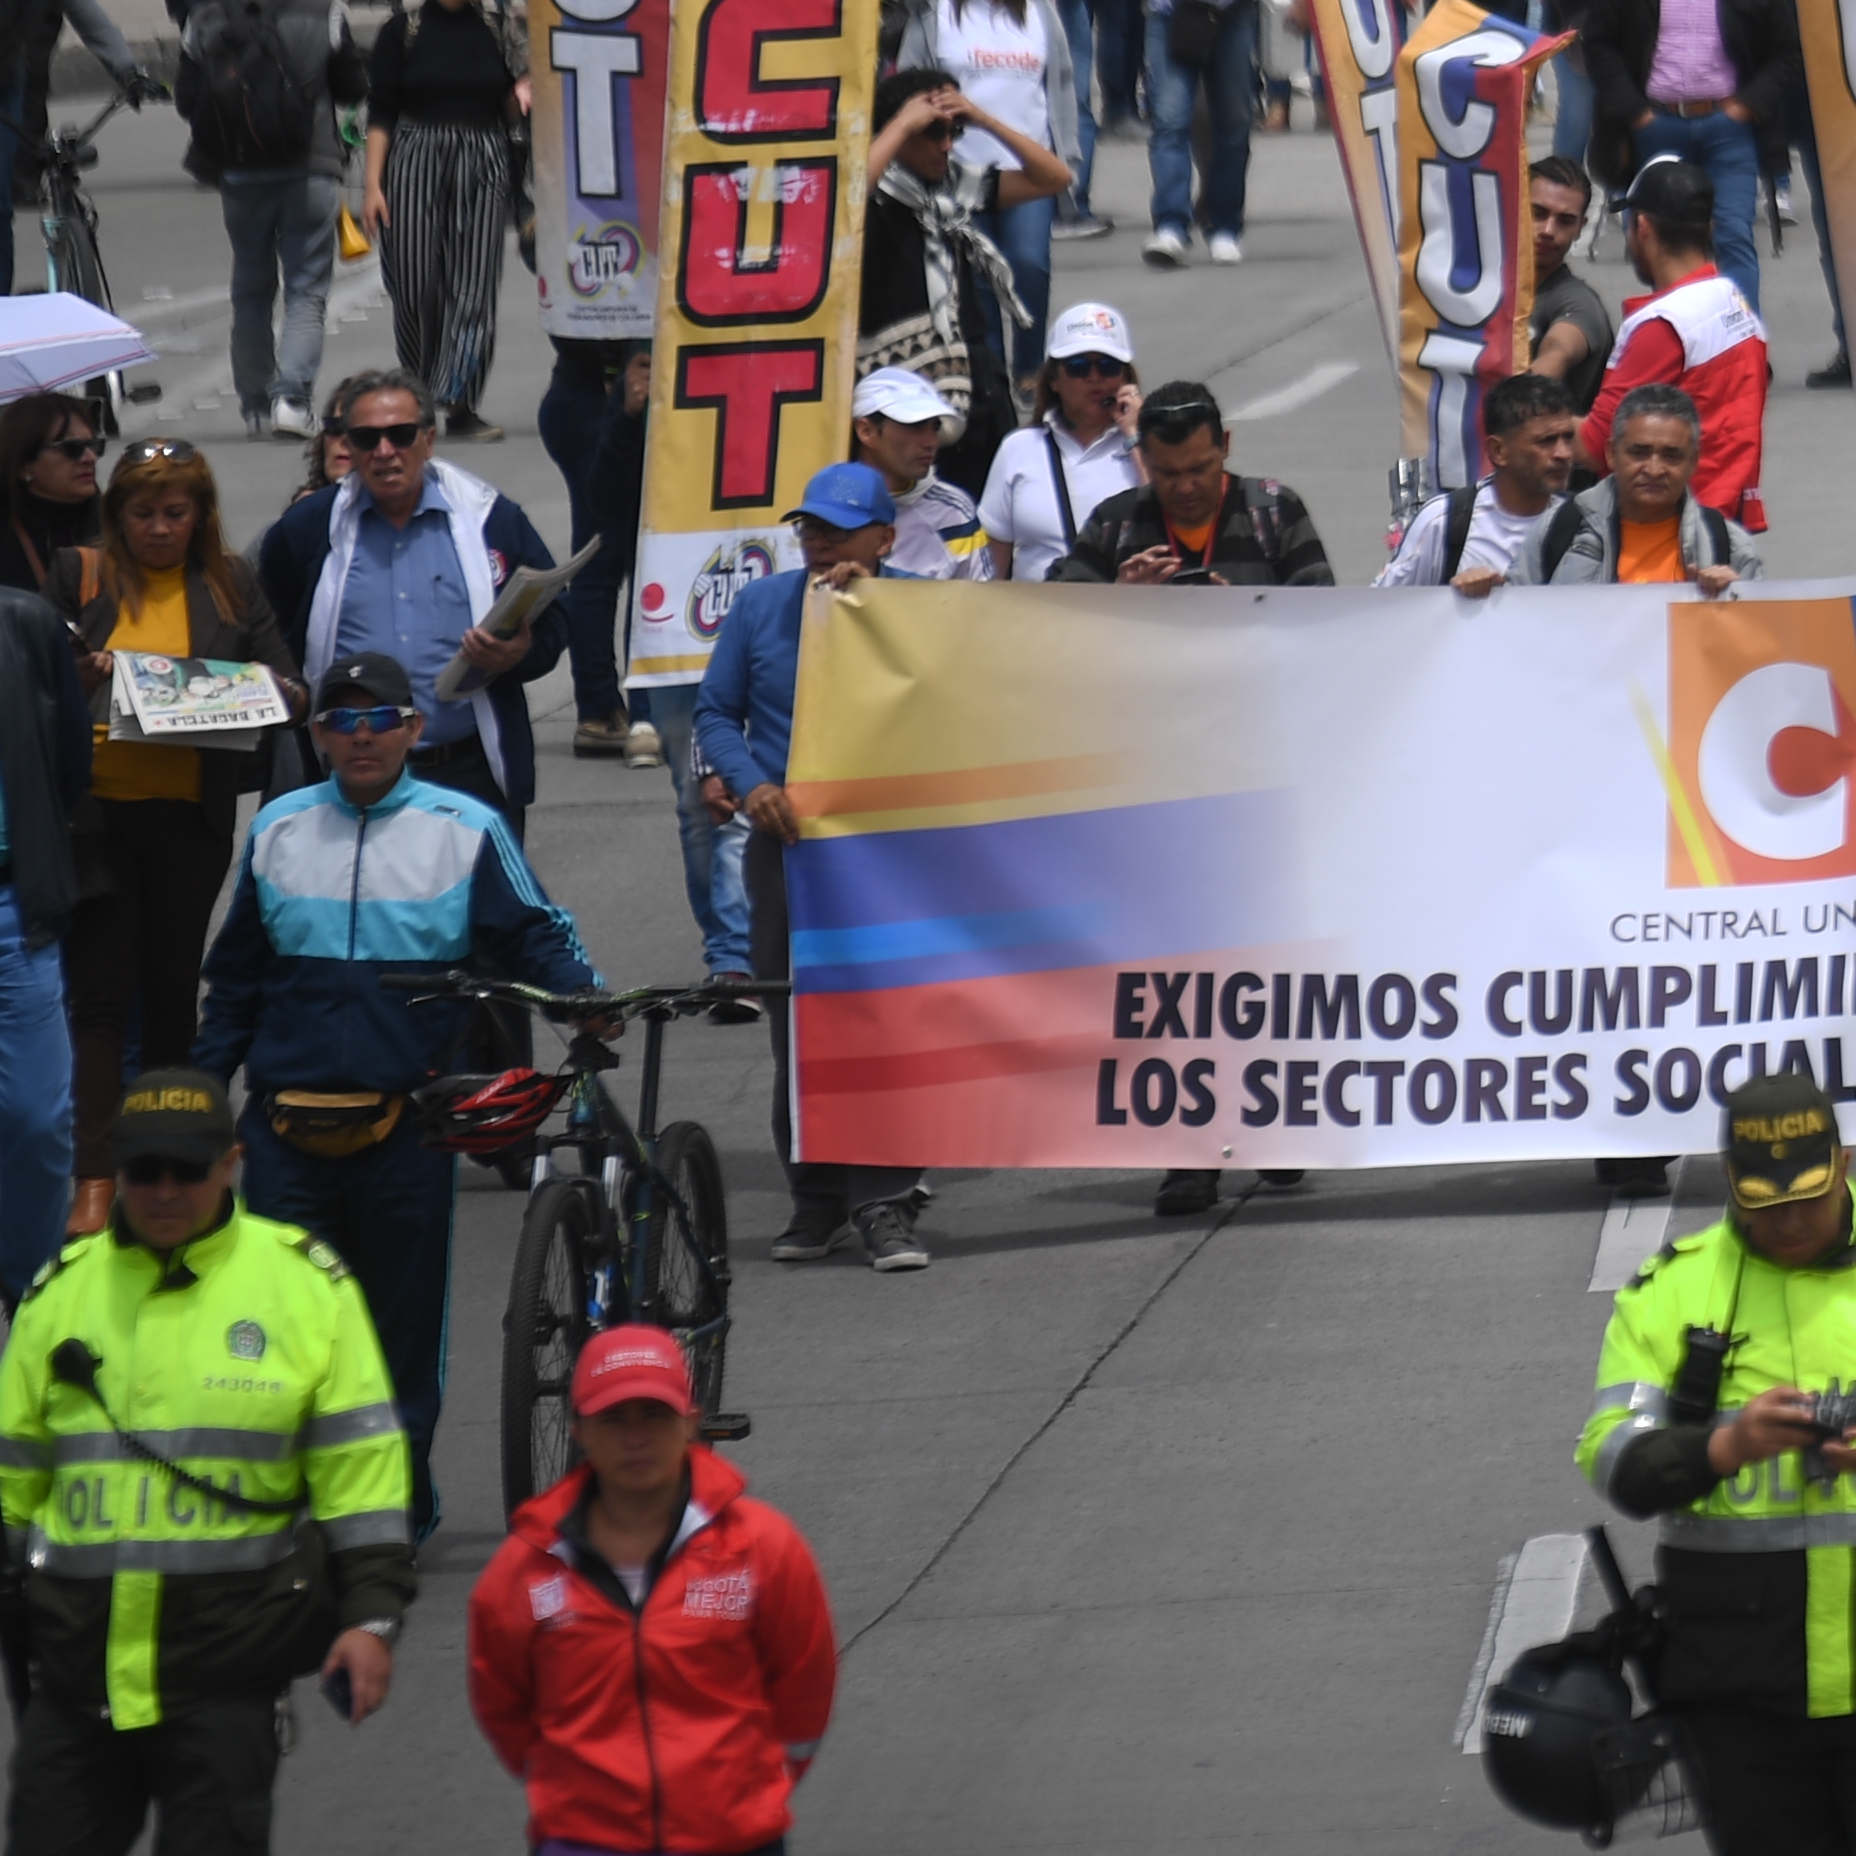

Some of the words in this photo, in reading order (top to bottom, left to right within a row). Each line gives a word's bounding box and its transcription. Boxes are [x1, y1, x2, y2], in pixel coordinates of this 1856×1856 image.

[971, 47, 1042, 75] fecode
[1412, 28, 1528, 492] CUT
[1610, 909, 1787, 943] CENTRAL
[1112, 970, 1459, 1041] EXIGIMOS
[121, 1086, 211, 1117] POLICIA
[1096, 1057, 1217, 1127] LOS
[1239, 1051, 1589, 1128] SECTORES
[1734, 1109, 1824, 1145] POLICIA
